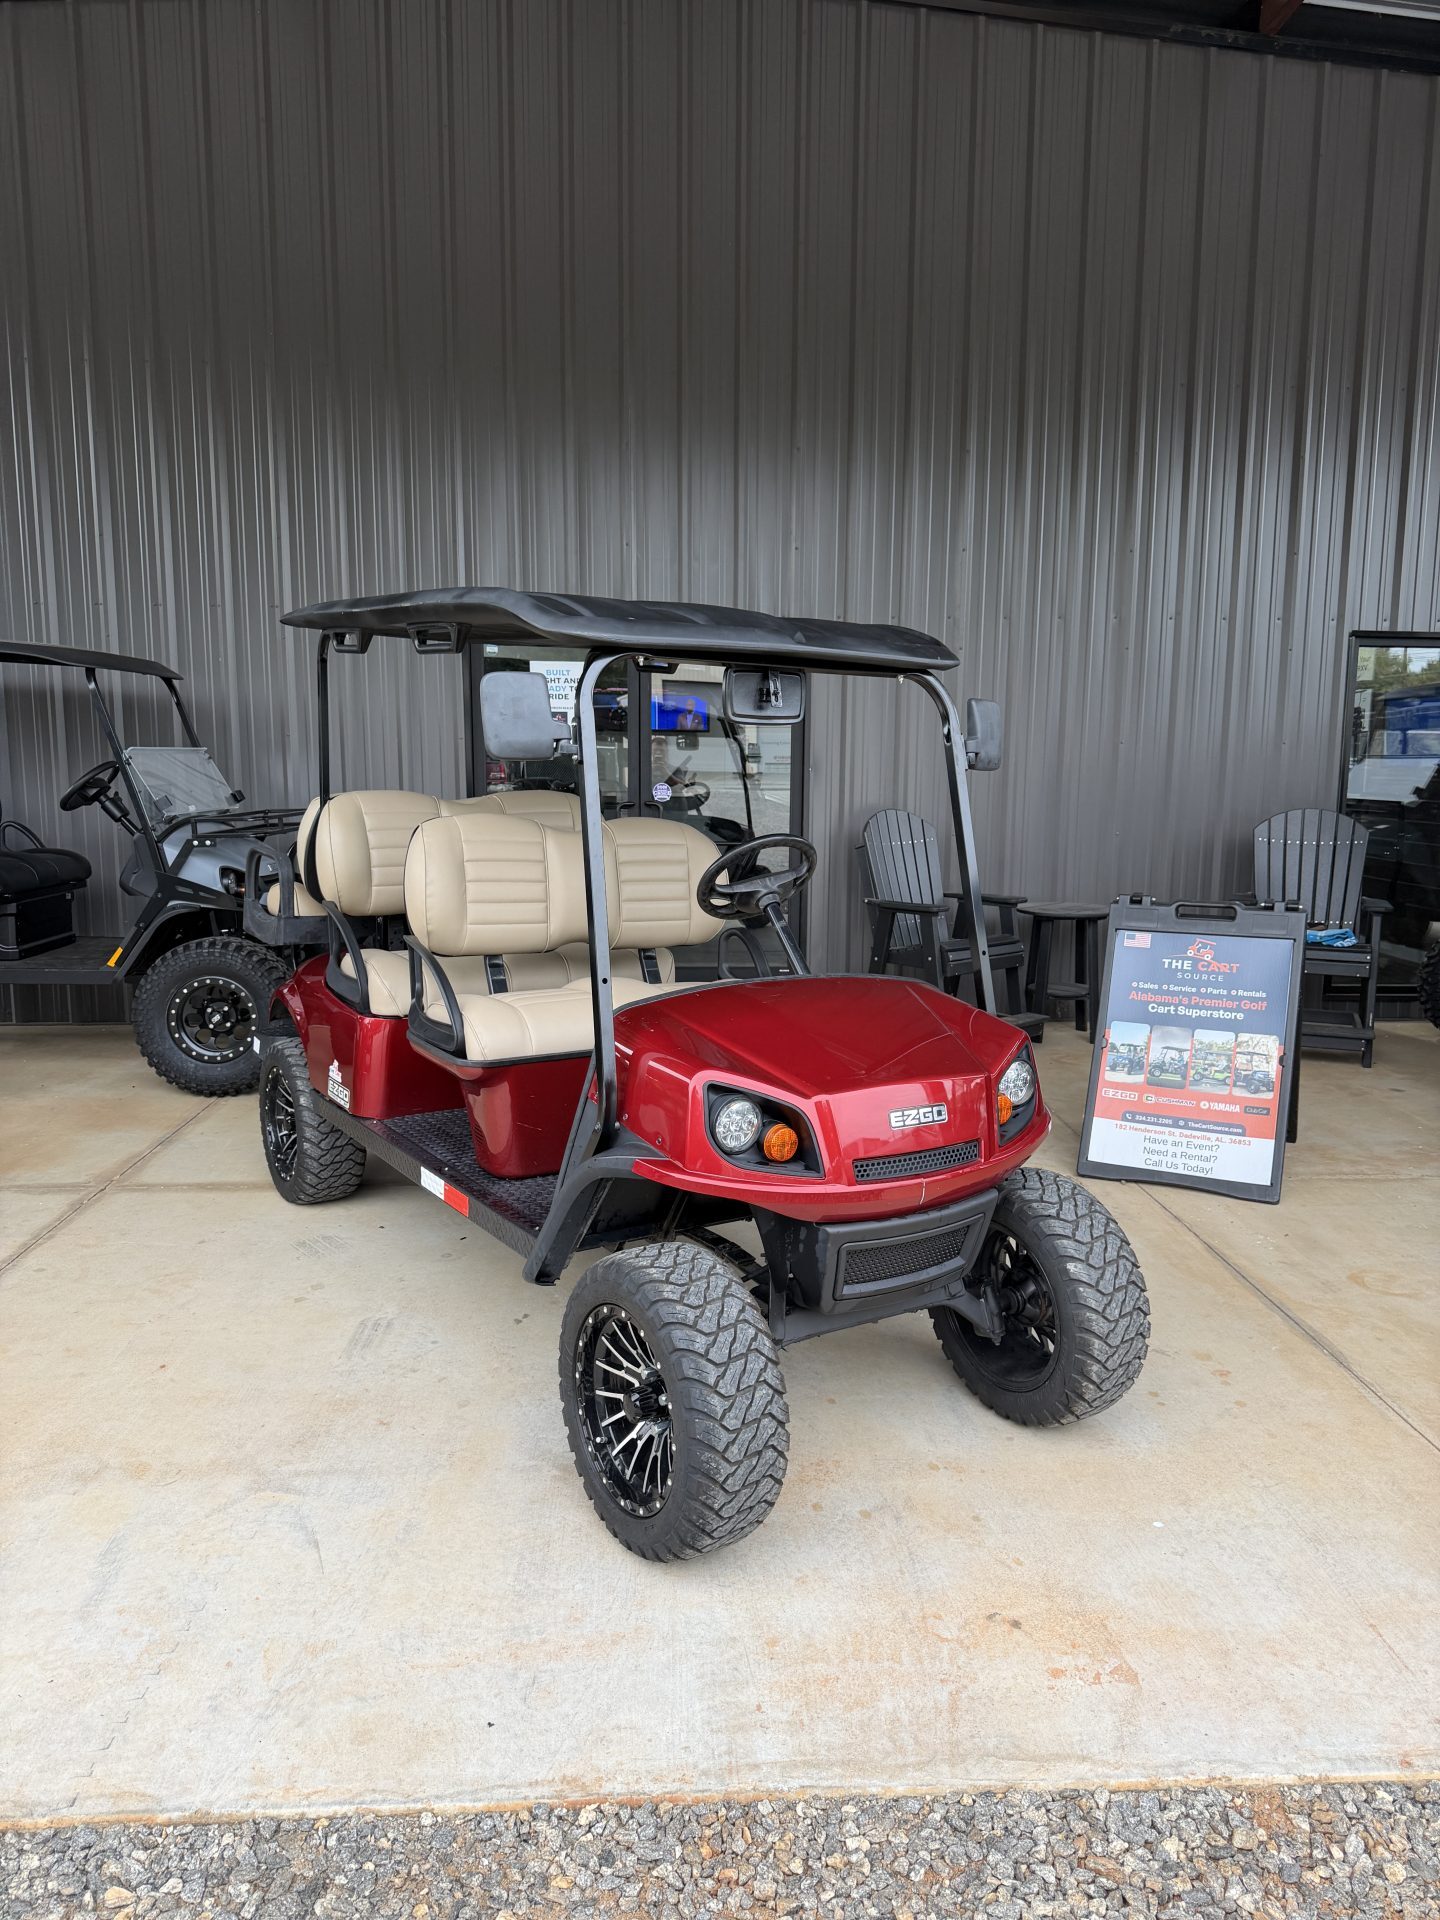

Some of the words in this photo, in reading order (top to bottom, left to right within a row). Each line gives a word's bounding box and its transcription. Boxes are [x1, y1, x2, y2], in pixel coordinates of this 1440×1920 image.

[1162, 958, 1192, 970] THE
[1197, 961, 1240, 973] CART
[1176, 972, 1224, 982] SOURCE
[1138, 982, 1158, 990] Sales
[1170, 984, 1196, 992] Service
[1238, 990, 1266, 998] Rentals
[1129, 990, 1188, 1004] Alabama's
[1191, 996, 1238, 1008] Premier
[1241, 1000, 1267, 1010] Golf
[1148, 1004, 1176, 1014] Cart
[1178, 1006, 1244, 1020] Superstore
[329, 1080, 349, 1103] EZGO
[1103, 1090, 1136, 1100] EZGO
[1210, 1102, 1240, 1112] YAMAHA
[890, 1105, 946, 1128] EZGO
[1188, 1122, 1242, 1132] TheCartSource.com
[1128, 1125, 1166, 1136] Henderson
[1179, 1132, 1213, 1142] Dadeville,
[1228, 1138, 1252, 1146] 36853
[1144, 1136, 1168, 1146] Have
[1186, 1140, 1220, 1152] Event?
[1143, 1146, 1168, 1157] Need
[1180, 1152, 1218, 1164] Rental?
[1144, 1158, 1162, 1168] Call
[1166, 1160, 1178, 1170] Us
[1182, 1162, 1214, 1176] Today!
